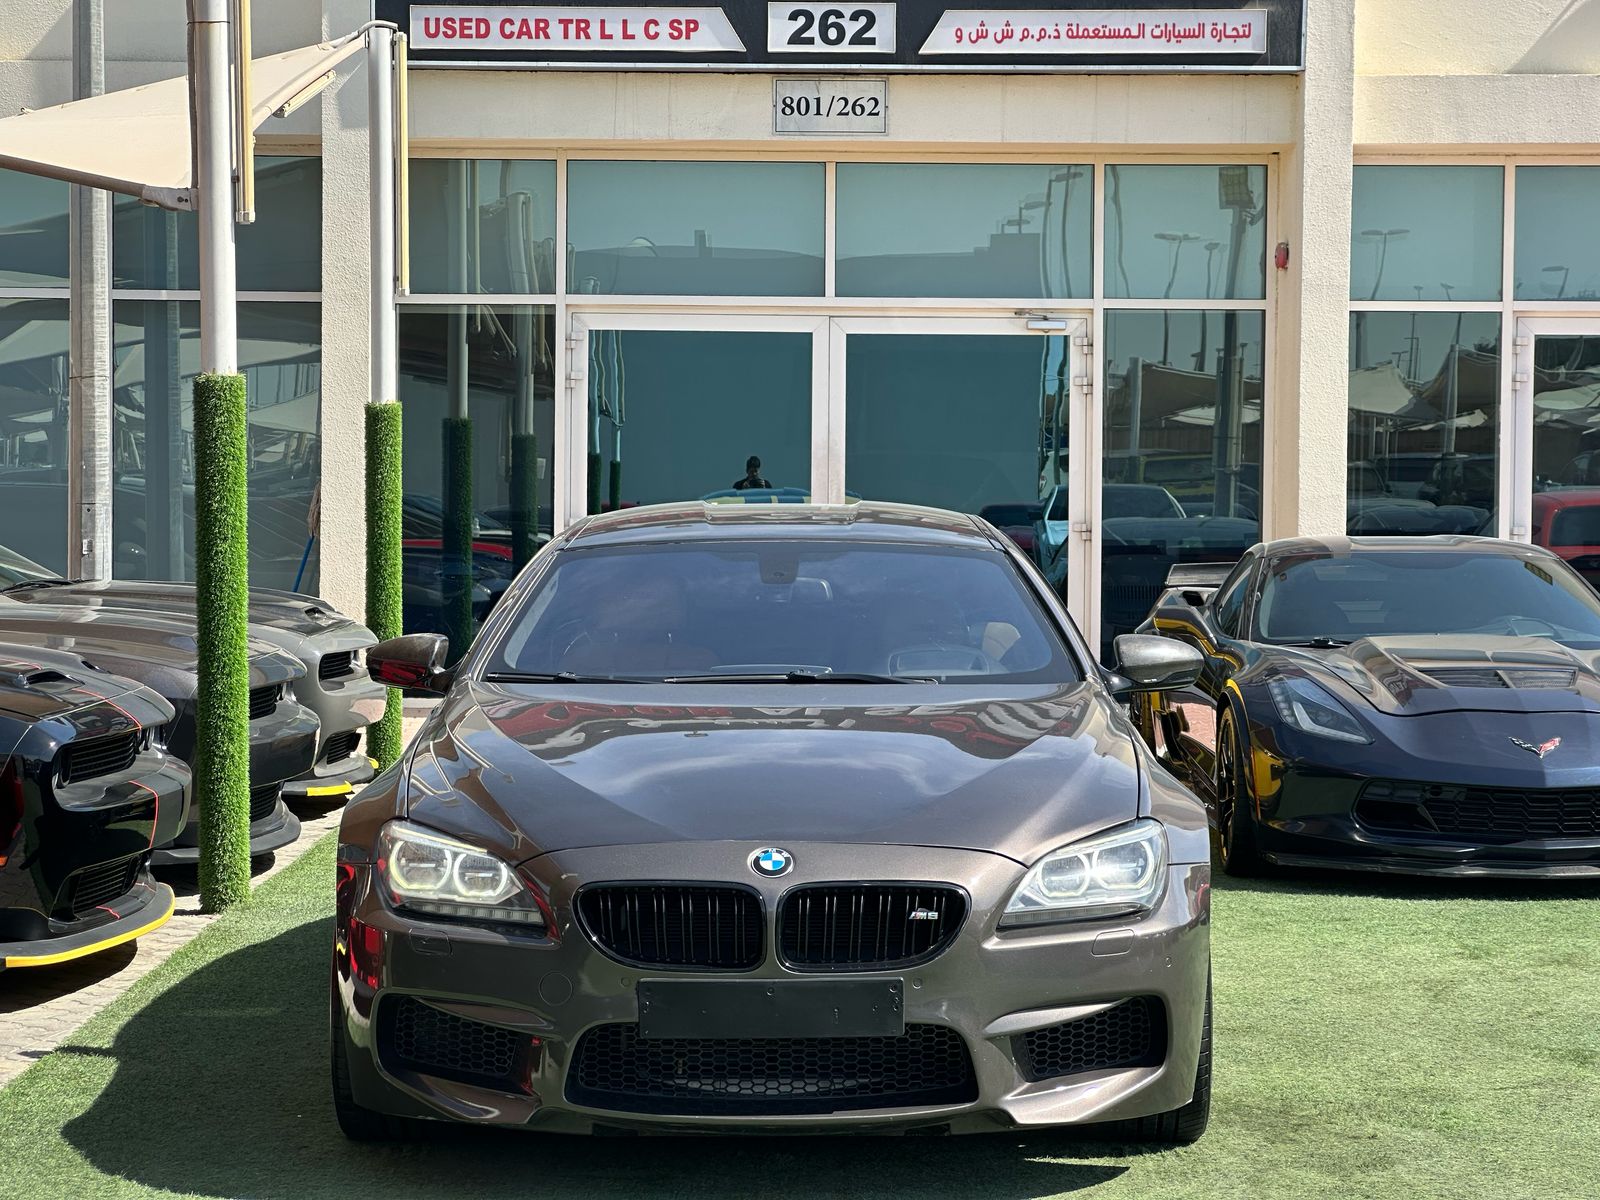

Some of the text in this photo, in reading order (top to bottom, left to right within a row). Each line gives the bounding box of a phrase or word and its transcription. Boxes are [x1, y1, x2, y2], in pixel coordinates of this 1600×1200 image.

[424, 17, 700, 41] USED CAR TR L L C SP
[786, 8, 877, 46] 262
[968, 21, 989, 44] ش
[993, 21, 1014, 44] ش
[1066, 23, 1146, 40] المستعملة
[1150, 23, 1205, 44] السيارات
[1210, 23, 1252, 43] لتجارة
[780, 95, 881, 117] 801/262
